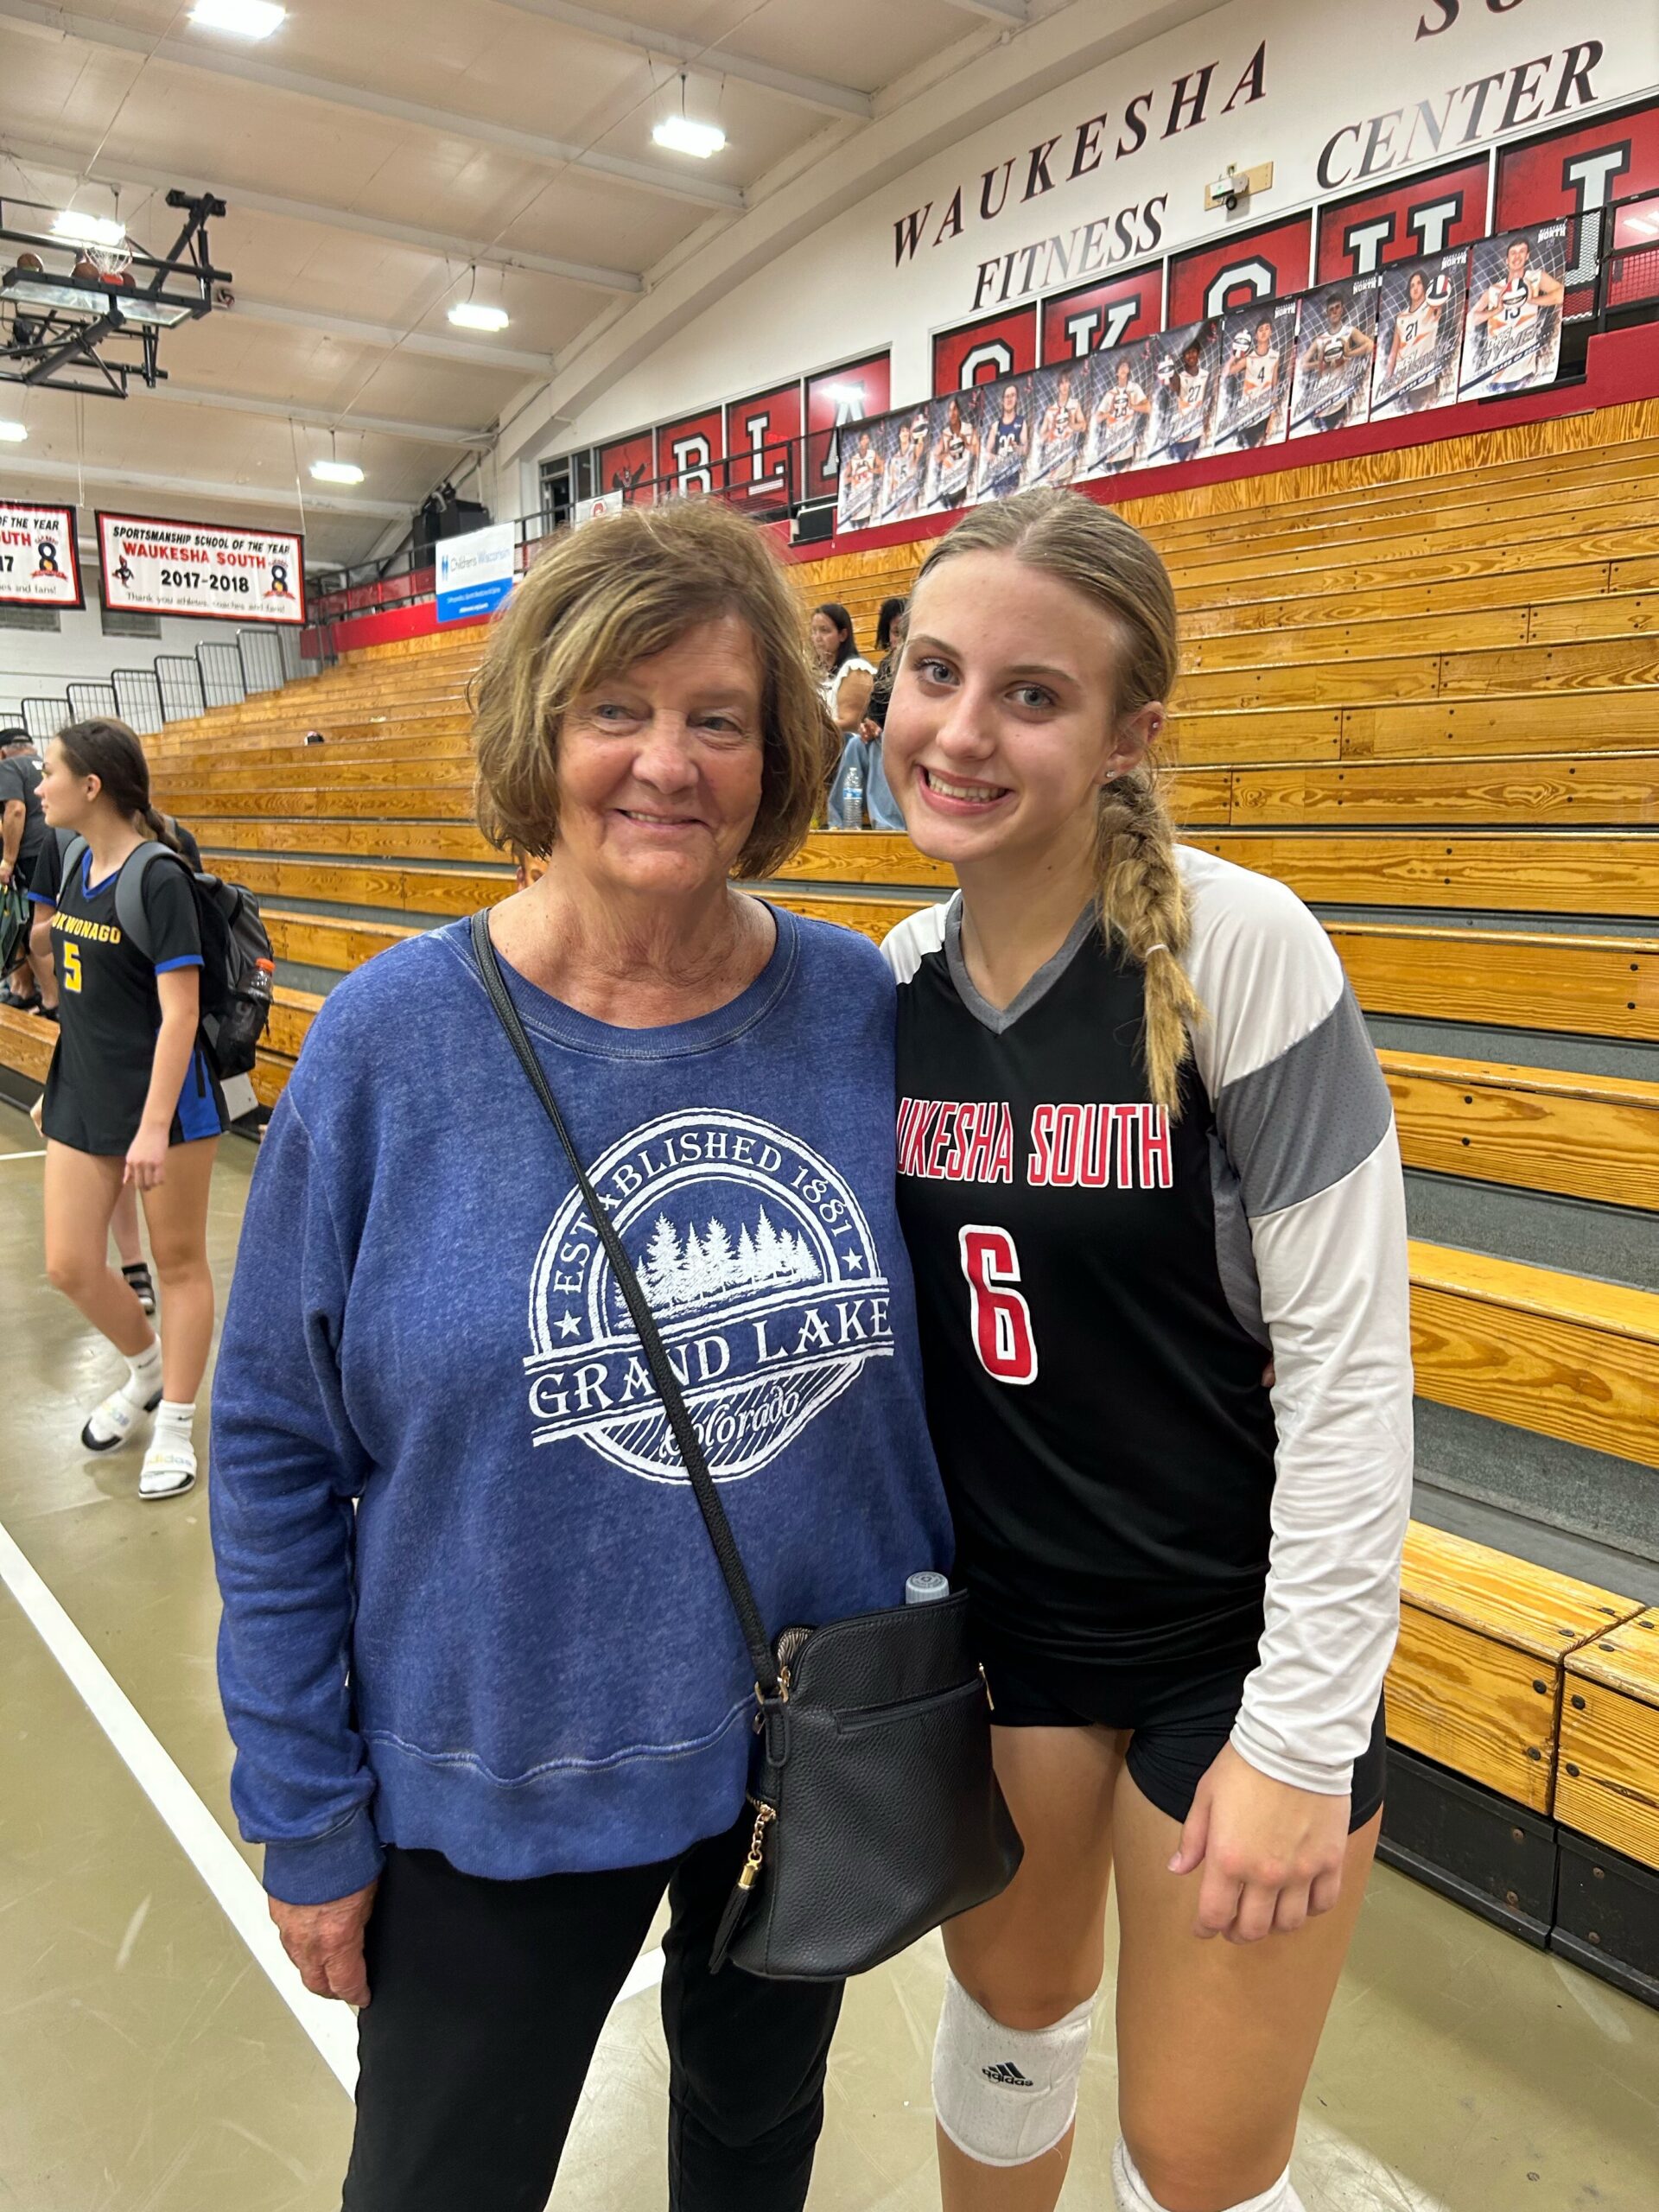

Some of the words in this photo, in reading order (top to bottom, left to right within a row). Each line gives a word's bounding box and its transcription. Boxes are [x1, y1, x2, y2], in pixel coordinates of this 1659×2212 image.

[893, 40, 1267, 268] WAUKESHA
[969, 194, 1168, 312] FITNESS
[1316, 40, 1604, 189] CENTER
[1405, 320, 1418, 342] 21
[1257, 366, 1266, 383] 4
[1188, 385, 1201, 403] 27
[11, 516, 29, 529] THE
[34, 518, 59, 531] YEAR
[0, 530, 32, 547] UTH
[113, 525, 191, 545] SPORTSMANSHIP
[194, 535, 228, 549] SCHOOL
[232, 539, 244, 550] OF
[248, 541, 264, 553] THE
[268, 543, 290, 554] YEAR
[122, 541, 210, 563] WAUKESHA
[216, 551, 266, 569] SOUTH
[161, 569, 250, 594] 2017-2018
[63, 940, 82, 995] 5
[896, 1096, 1014, 1184] UKESHA
[1027, 1103, 1173, 1190] SOUTH
[553, 1130, 783, 1294] ESTABLISHED
[790, 1166, 854, 1239] 1881
[958, 1224, 1038, 1386] 6
[527, 1335, 731, 1419] GRAND
[753, 1297, 894, 1363] LAKE
[982, 2068, 1033, 2087] adidas
